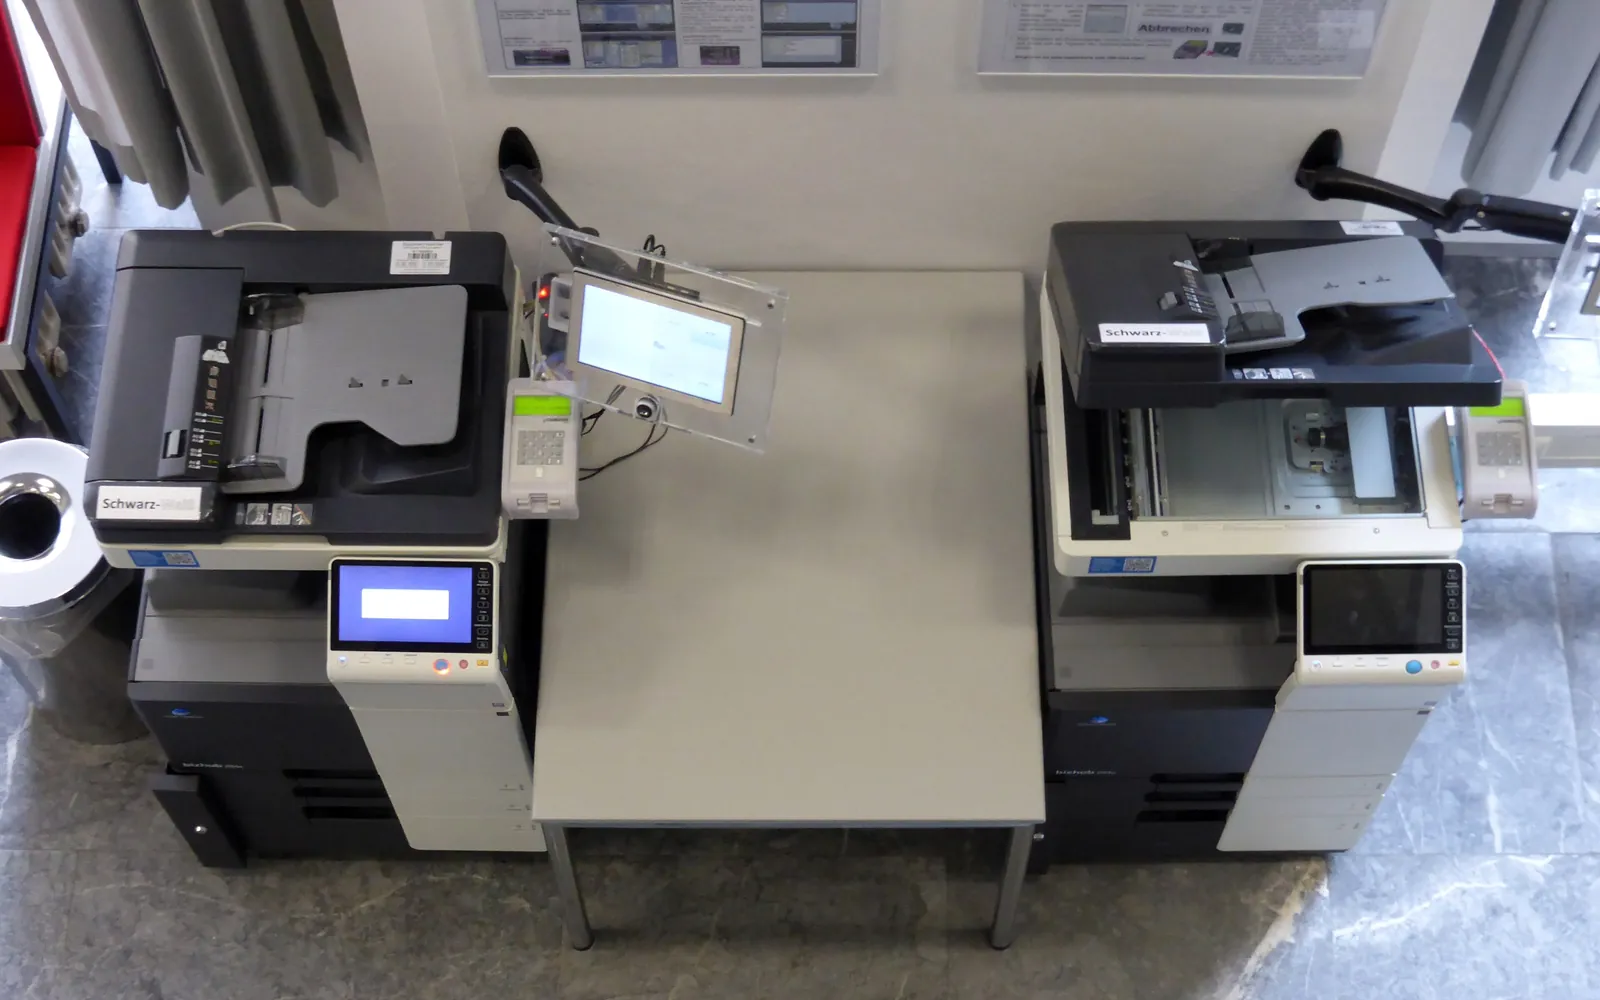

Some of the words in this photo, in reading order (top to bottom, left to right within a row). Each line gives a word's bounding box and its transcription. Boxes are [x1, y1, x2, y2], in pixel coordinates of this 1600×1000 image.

[1138, 24, 1210, 33] Abbrechen
[1106, 329, 1166, 337] Schwarz-
[102, 498, 160, 510] Schwarz-
